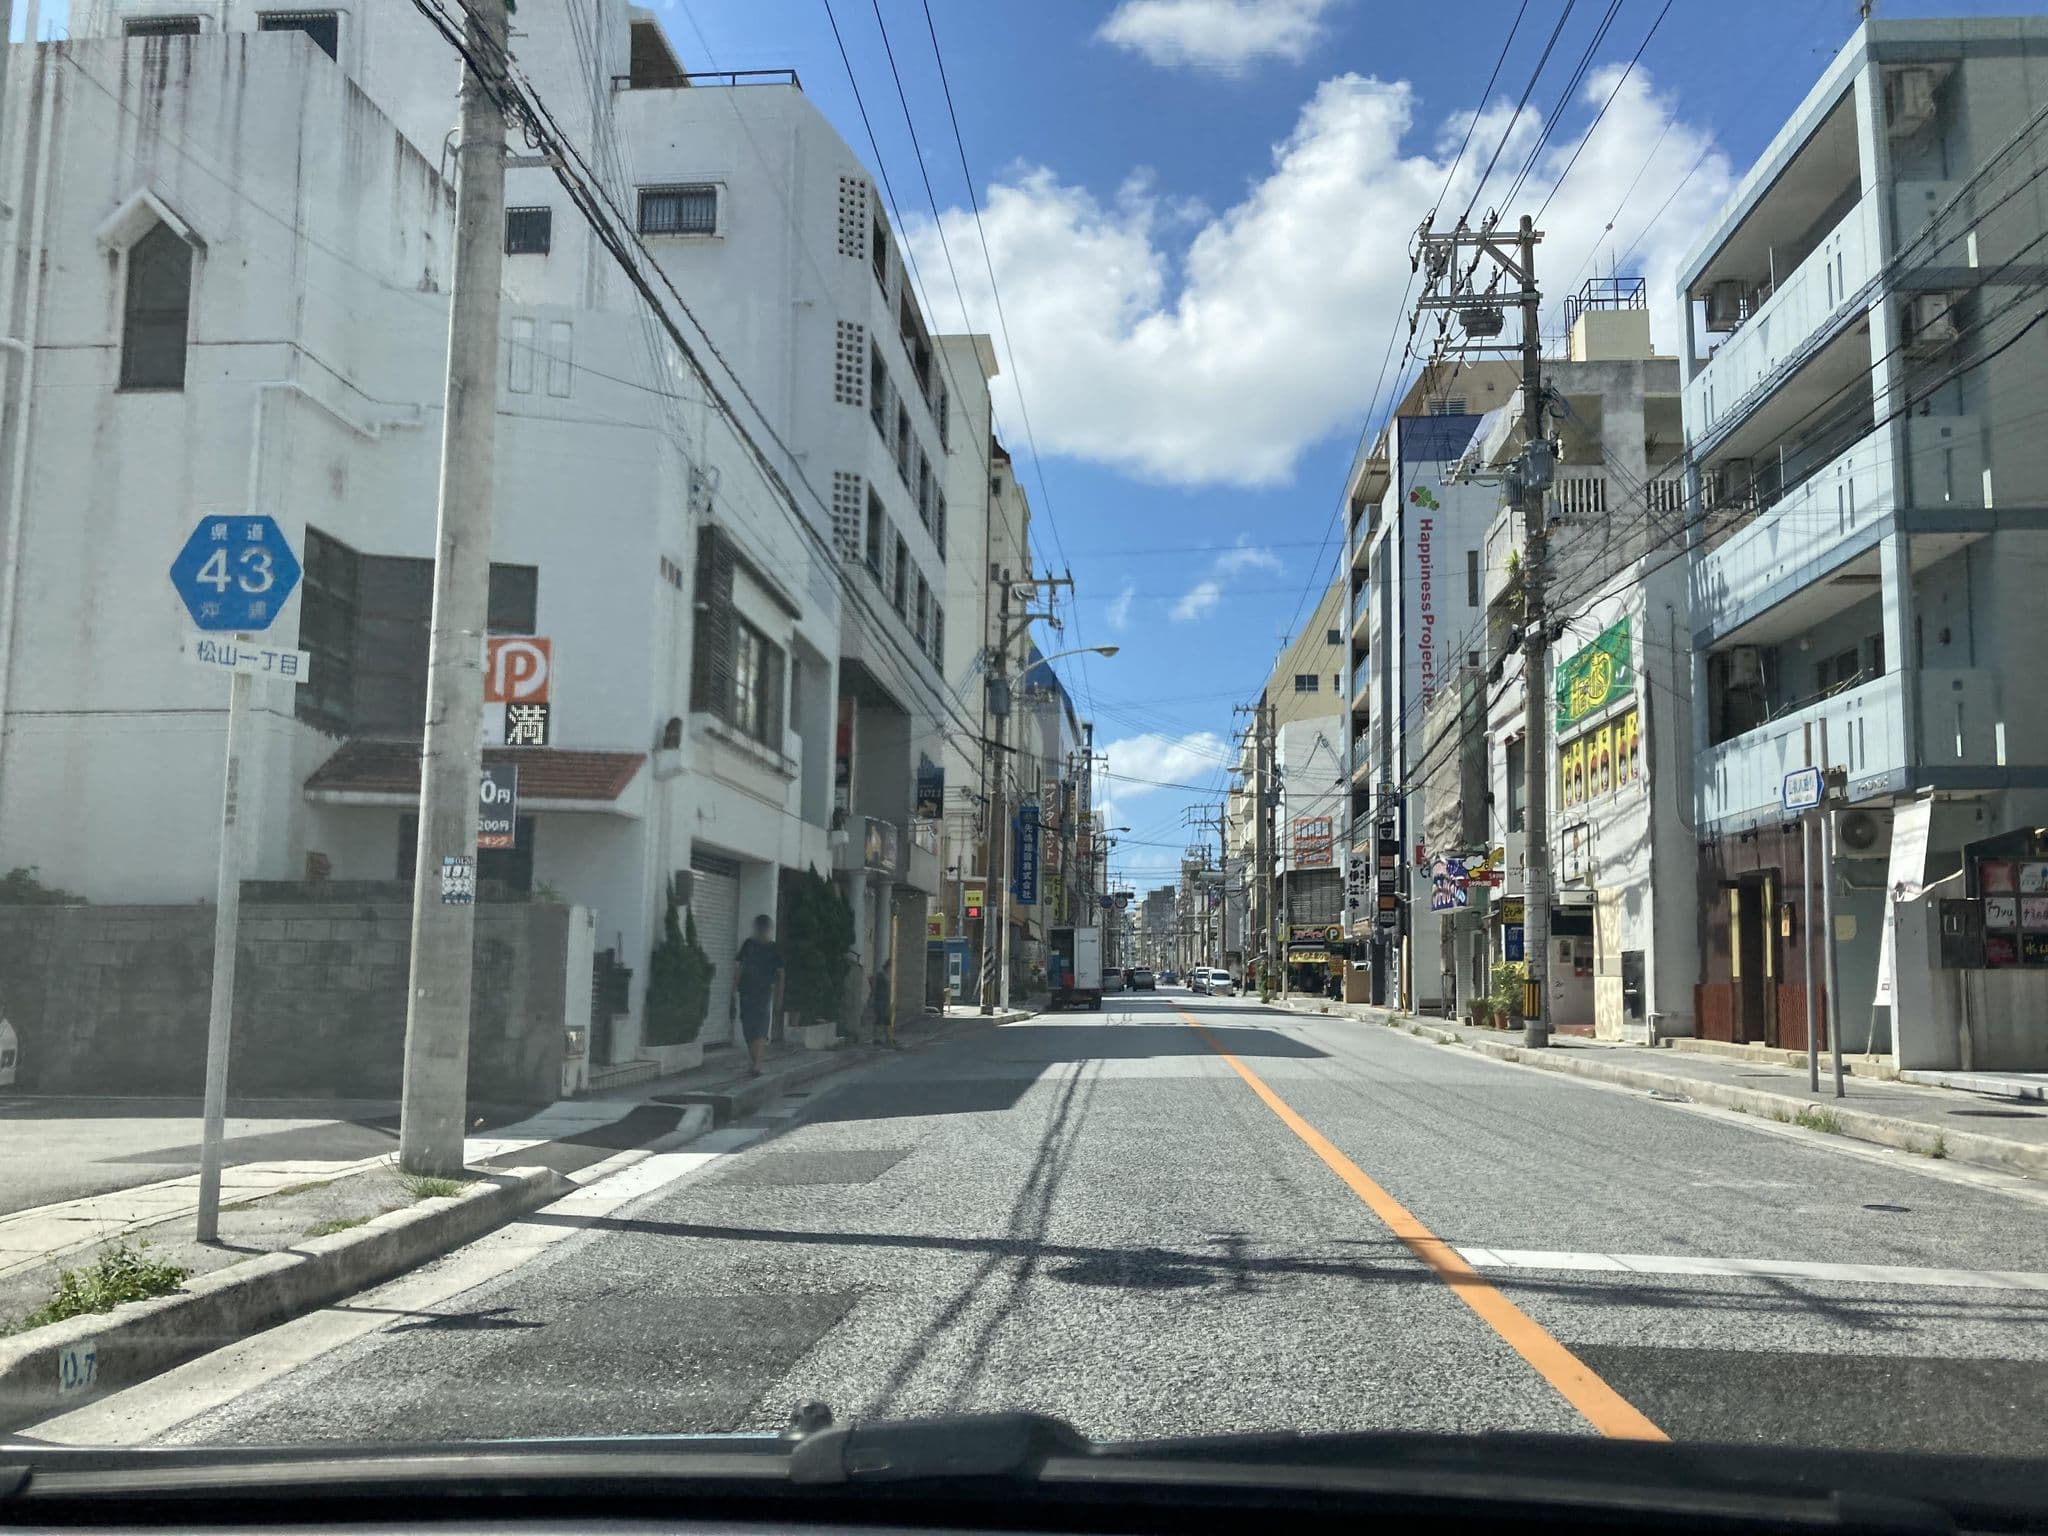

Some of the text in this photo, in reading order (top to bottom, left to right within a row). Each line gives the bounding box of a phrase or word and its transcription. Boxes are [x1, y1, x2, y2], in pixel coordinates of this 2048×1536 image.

[196, 548, 274, 593] 43
[198, 640, 298, 675] 松山一丁目
[507, 704, 547, 745] 満
[1329, 929, 1338, 940] P
